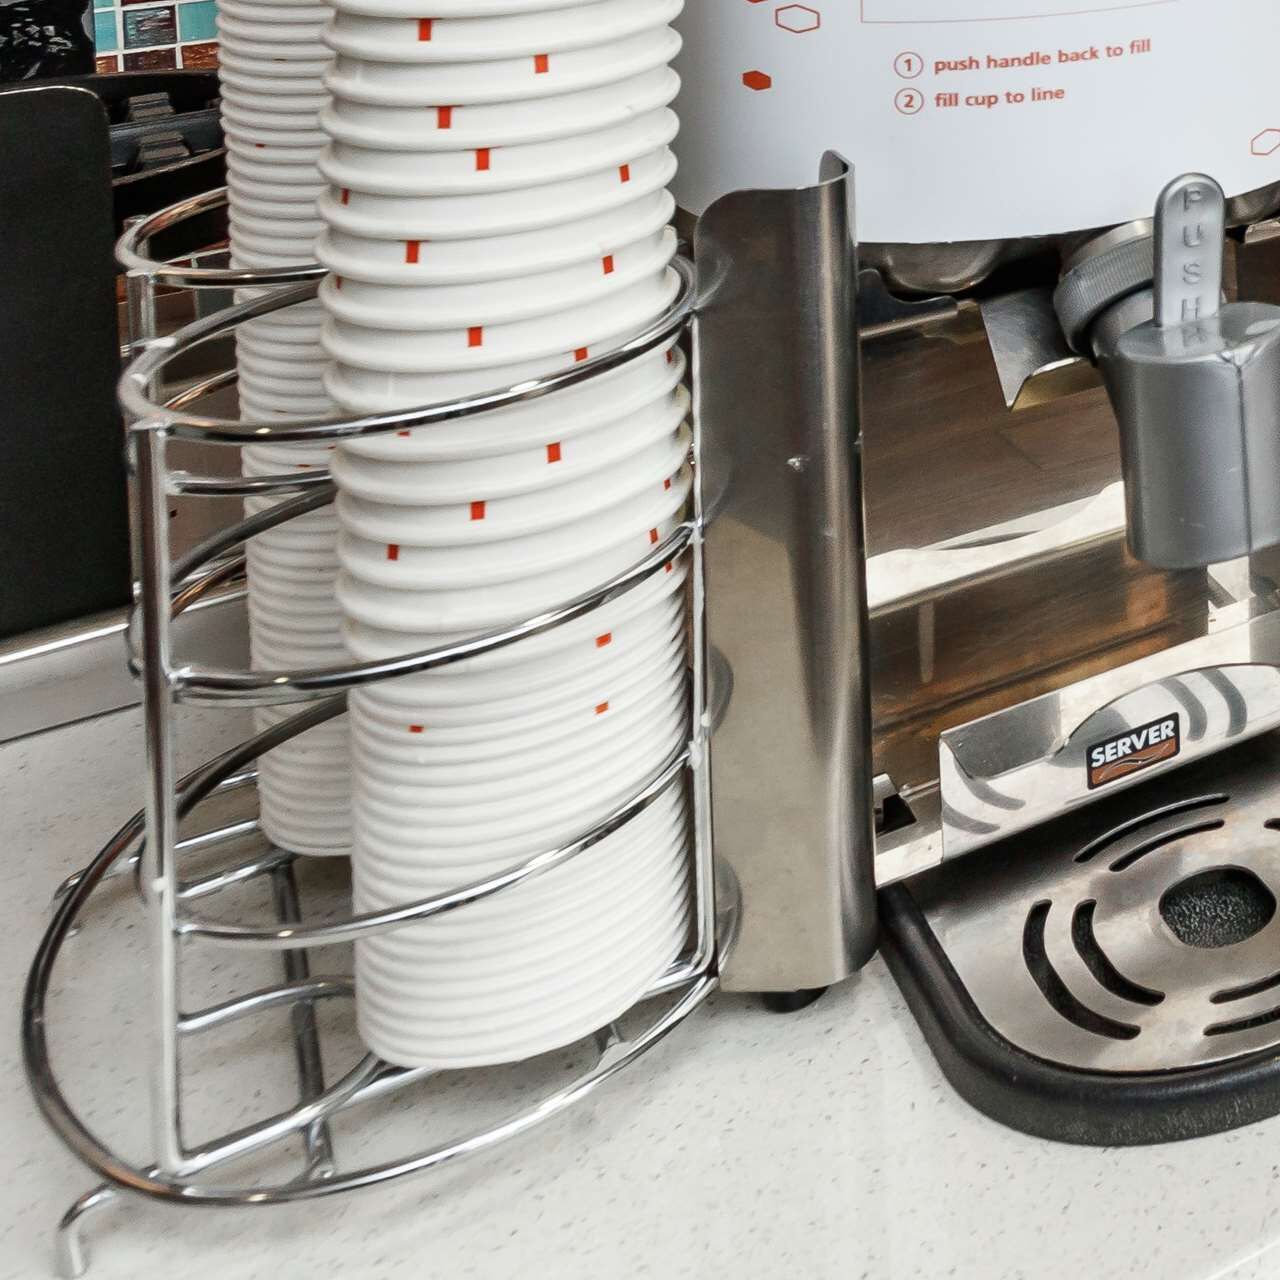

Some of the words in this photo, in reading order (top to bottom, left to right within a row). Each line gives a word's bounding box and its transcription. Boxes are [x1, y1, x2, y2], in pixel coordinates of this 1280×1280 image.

[934, 55, 980, 75] push
[986, 51, 1051, 70] handle
[1058, 46, 1099, 64] back
[1106, 45, 1124, 58] to
[1130, 38, 1152, 55] fill
[934, 92, 959, 108] fill
[965, 92, 999, 109] cup
[1005, 90, 1025, 104] to
[1031, 87, 1065, 102] line
[1182, 188, 1202, 321] PUSH
[1091, 720, 1175, 768] SERVER
